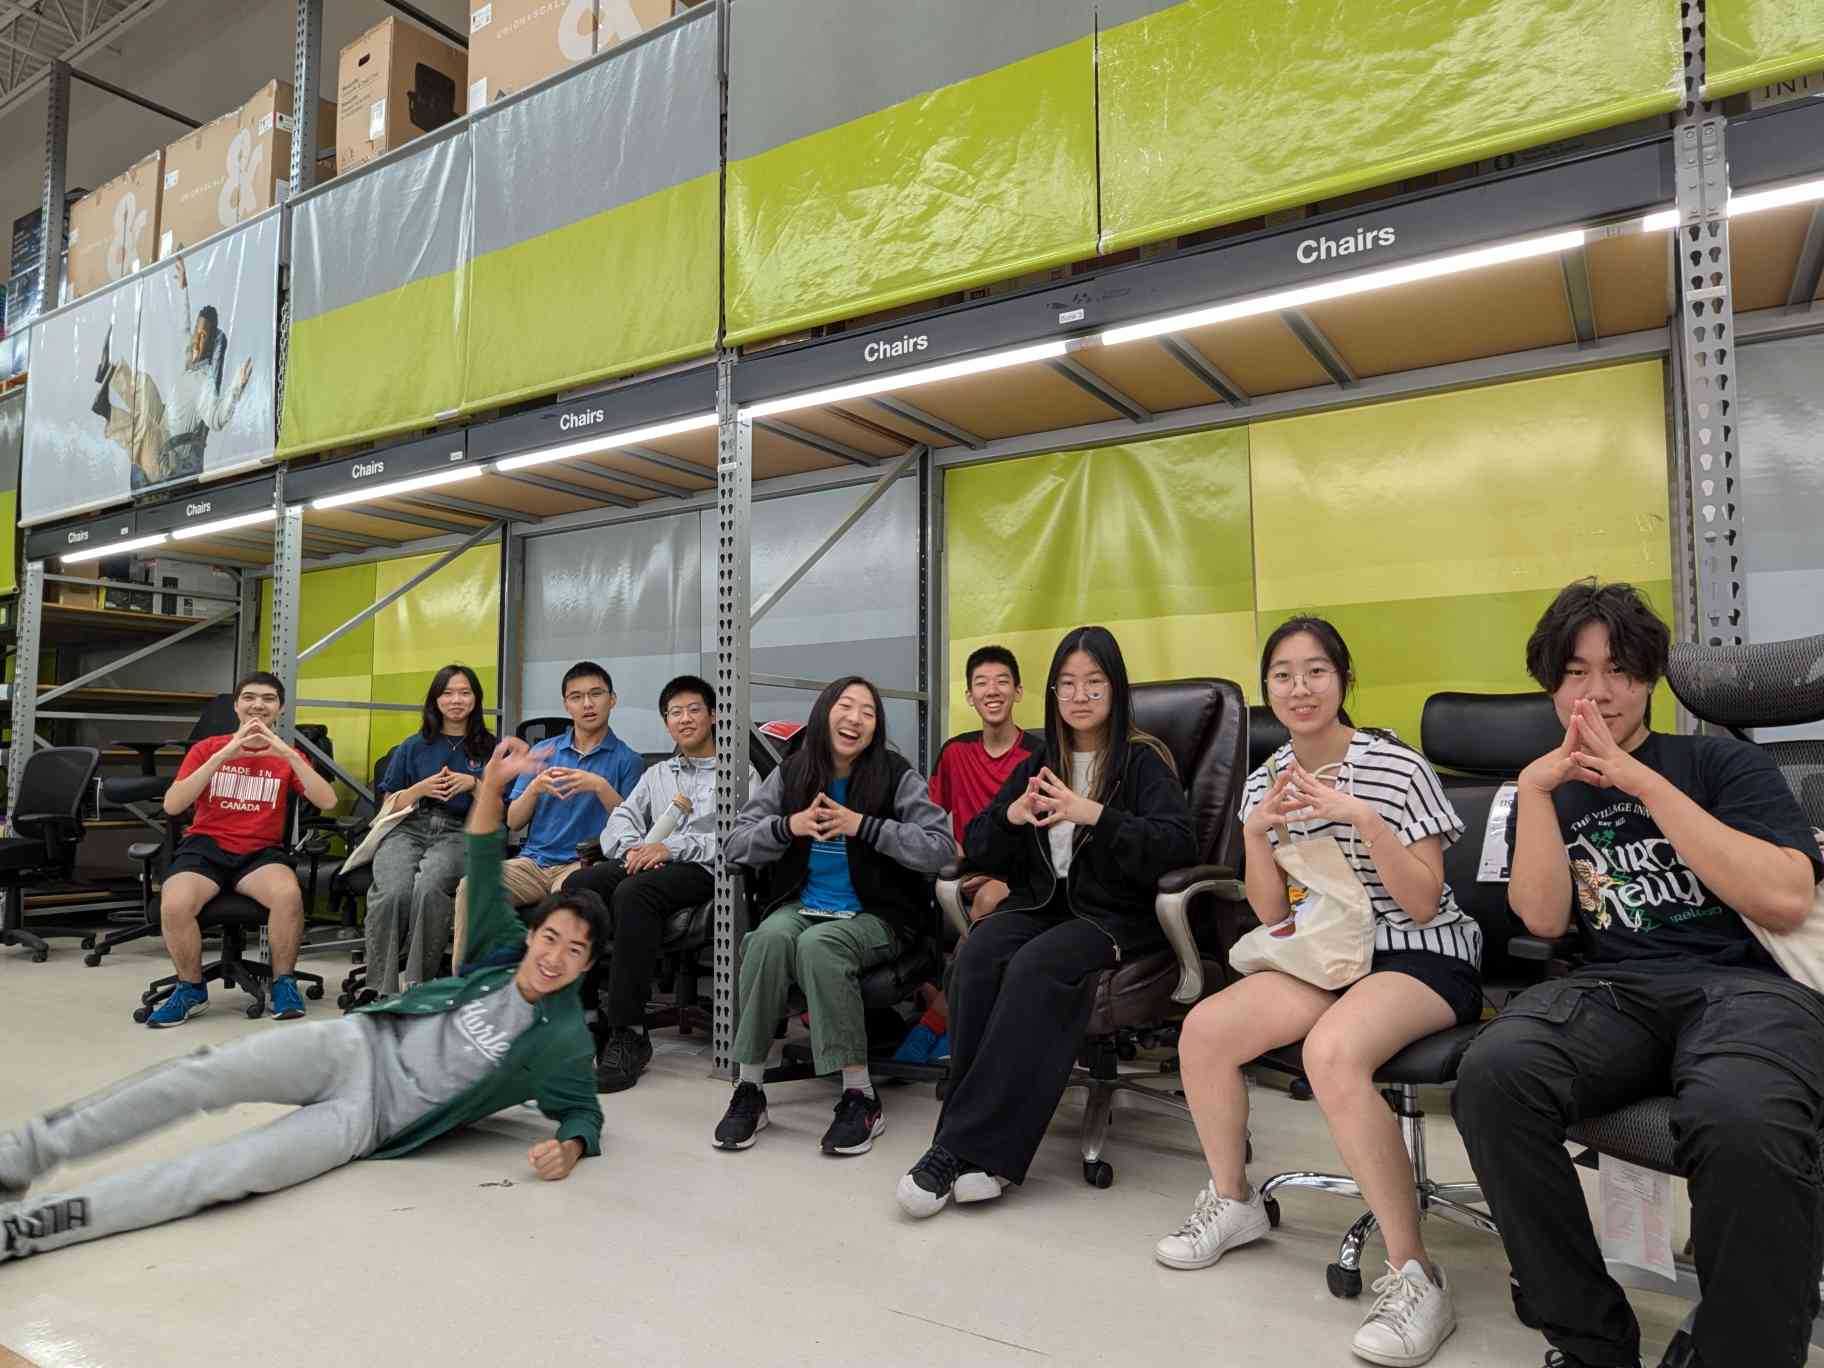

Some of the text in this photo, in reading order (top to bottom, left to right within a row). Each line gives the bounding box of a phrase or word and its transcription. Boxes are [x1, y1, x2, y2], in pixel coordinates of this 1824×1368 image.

[1296, 227, 1396, 264] Chairs
[864, 335, 929, 362] Chairs
[560, 408, 605, 430] Chairs
[351, 460, 384, 479] Chairs
[186, 501, 212, 517] Chairs
[67, 529, 89, 544] Chairs
[222, 764, 273, 778] MADE IN
[220, 800, 261, 813] CANADA
[1570, 814, 1592, 833] THE
[1592, 801, 1632, 820] VILLAGE
[454, 1000, 511, 1061] Hurle
